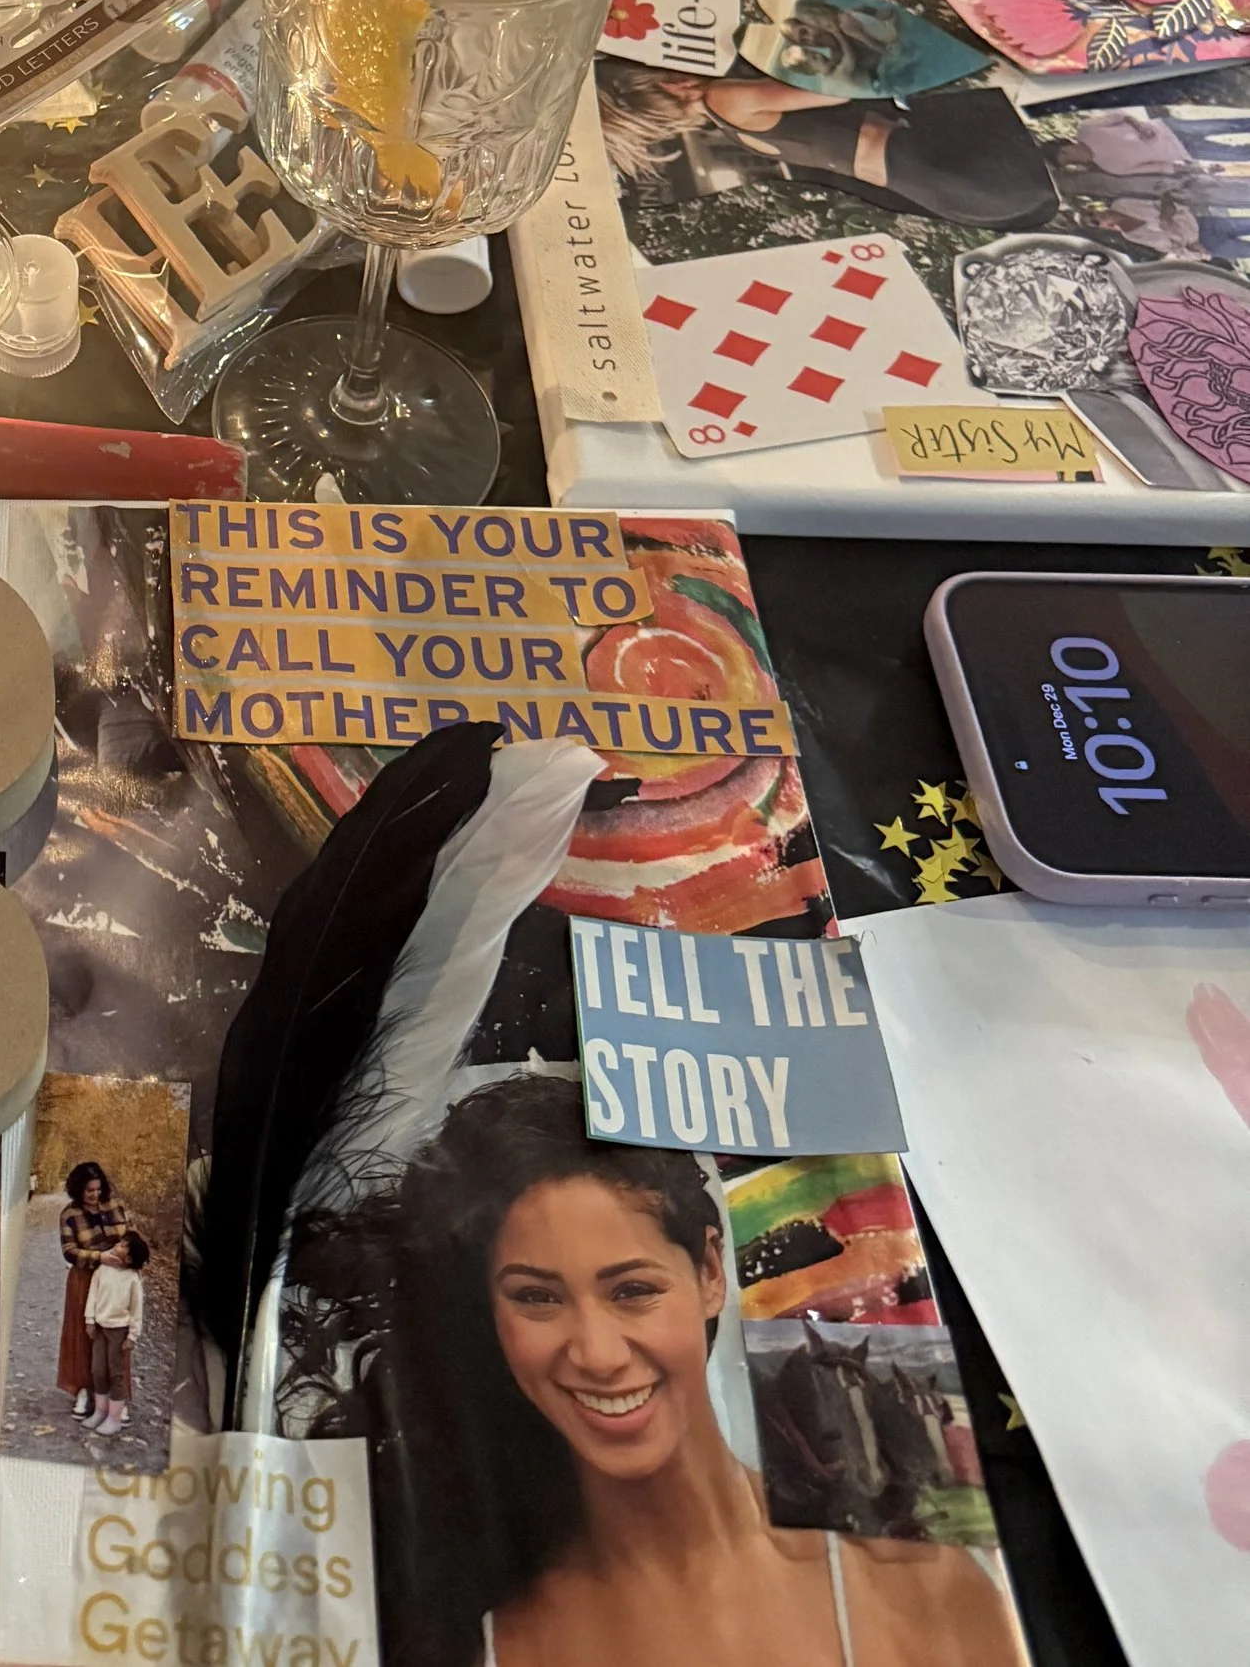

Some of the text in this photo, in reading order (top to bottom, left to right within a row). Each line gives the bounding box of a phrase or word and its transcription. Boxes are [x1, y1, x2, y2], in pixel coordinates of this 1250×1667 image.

[17, 16, 100, 76] LETTERS
[565, 200, 617, 372] saltwater
[850, 242, 886, 263] 8
[688, 422, 727, 448] 8
[178, 503, 610, 559] THIS IS YOUR
[180, 563, 637, 619] REMINDER TO
[182, 624, 566, 682] CALL YOUR
[499, 699, 784, 756] NATURE
[1040, 683, 1078, 761] Mon Dec 29
[1050, 636, 1169, 816] 10:10
[573, 918, 868, 1028] TELL THE
[583, 1037, 791, 1149] STORY
[88, 1513, 353, 1600] Goddess
[79, 1590, 361, 1667] Getaway
